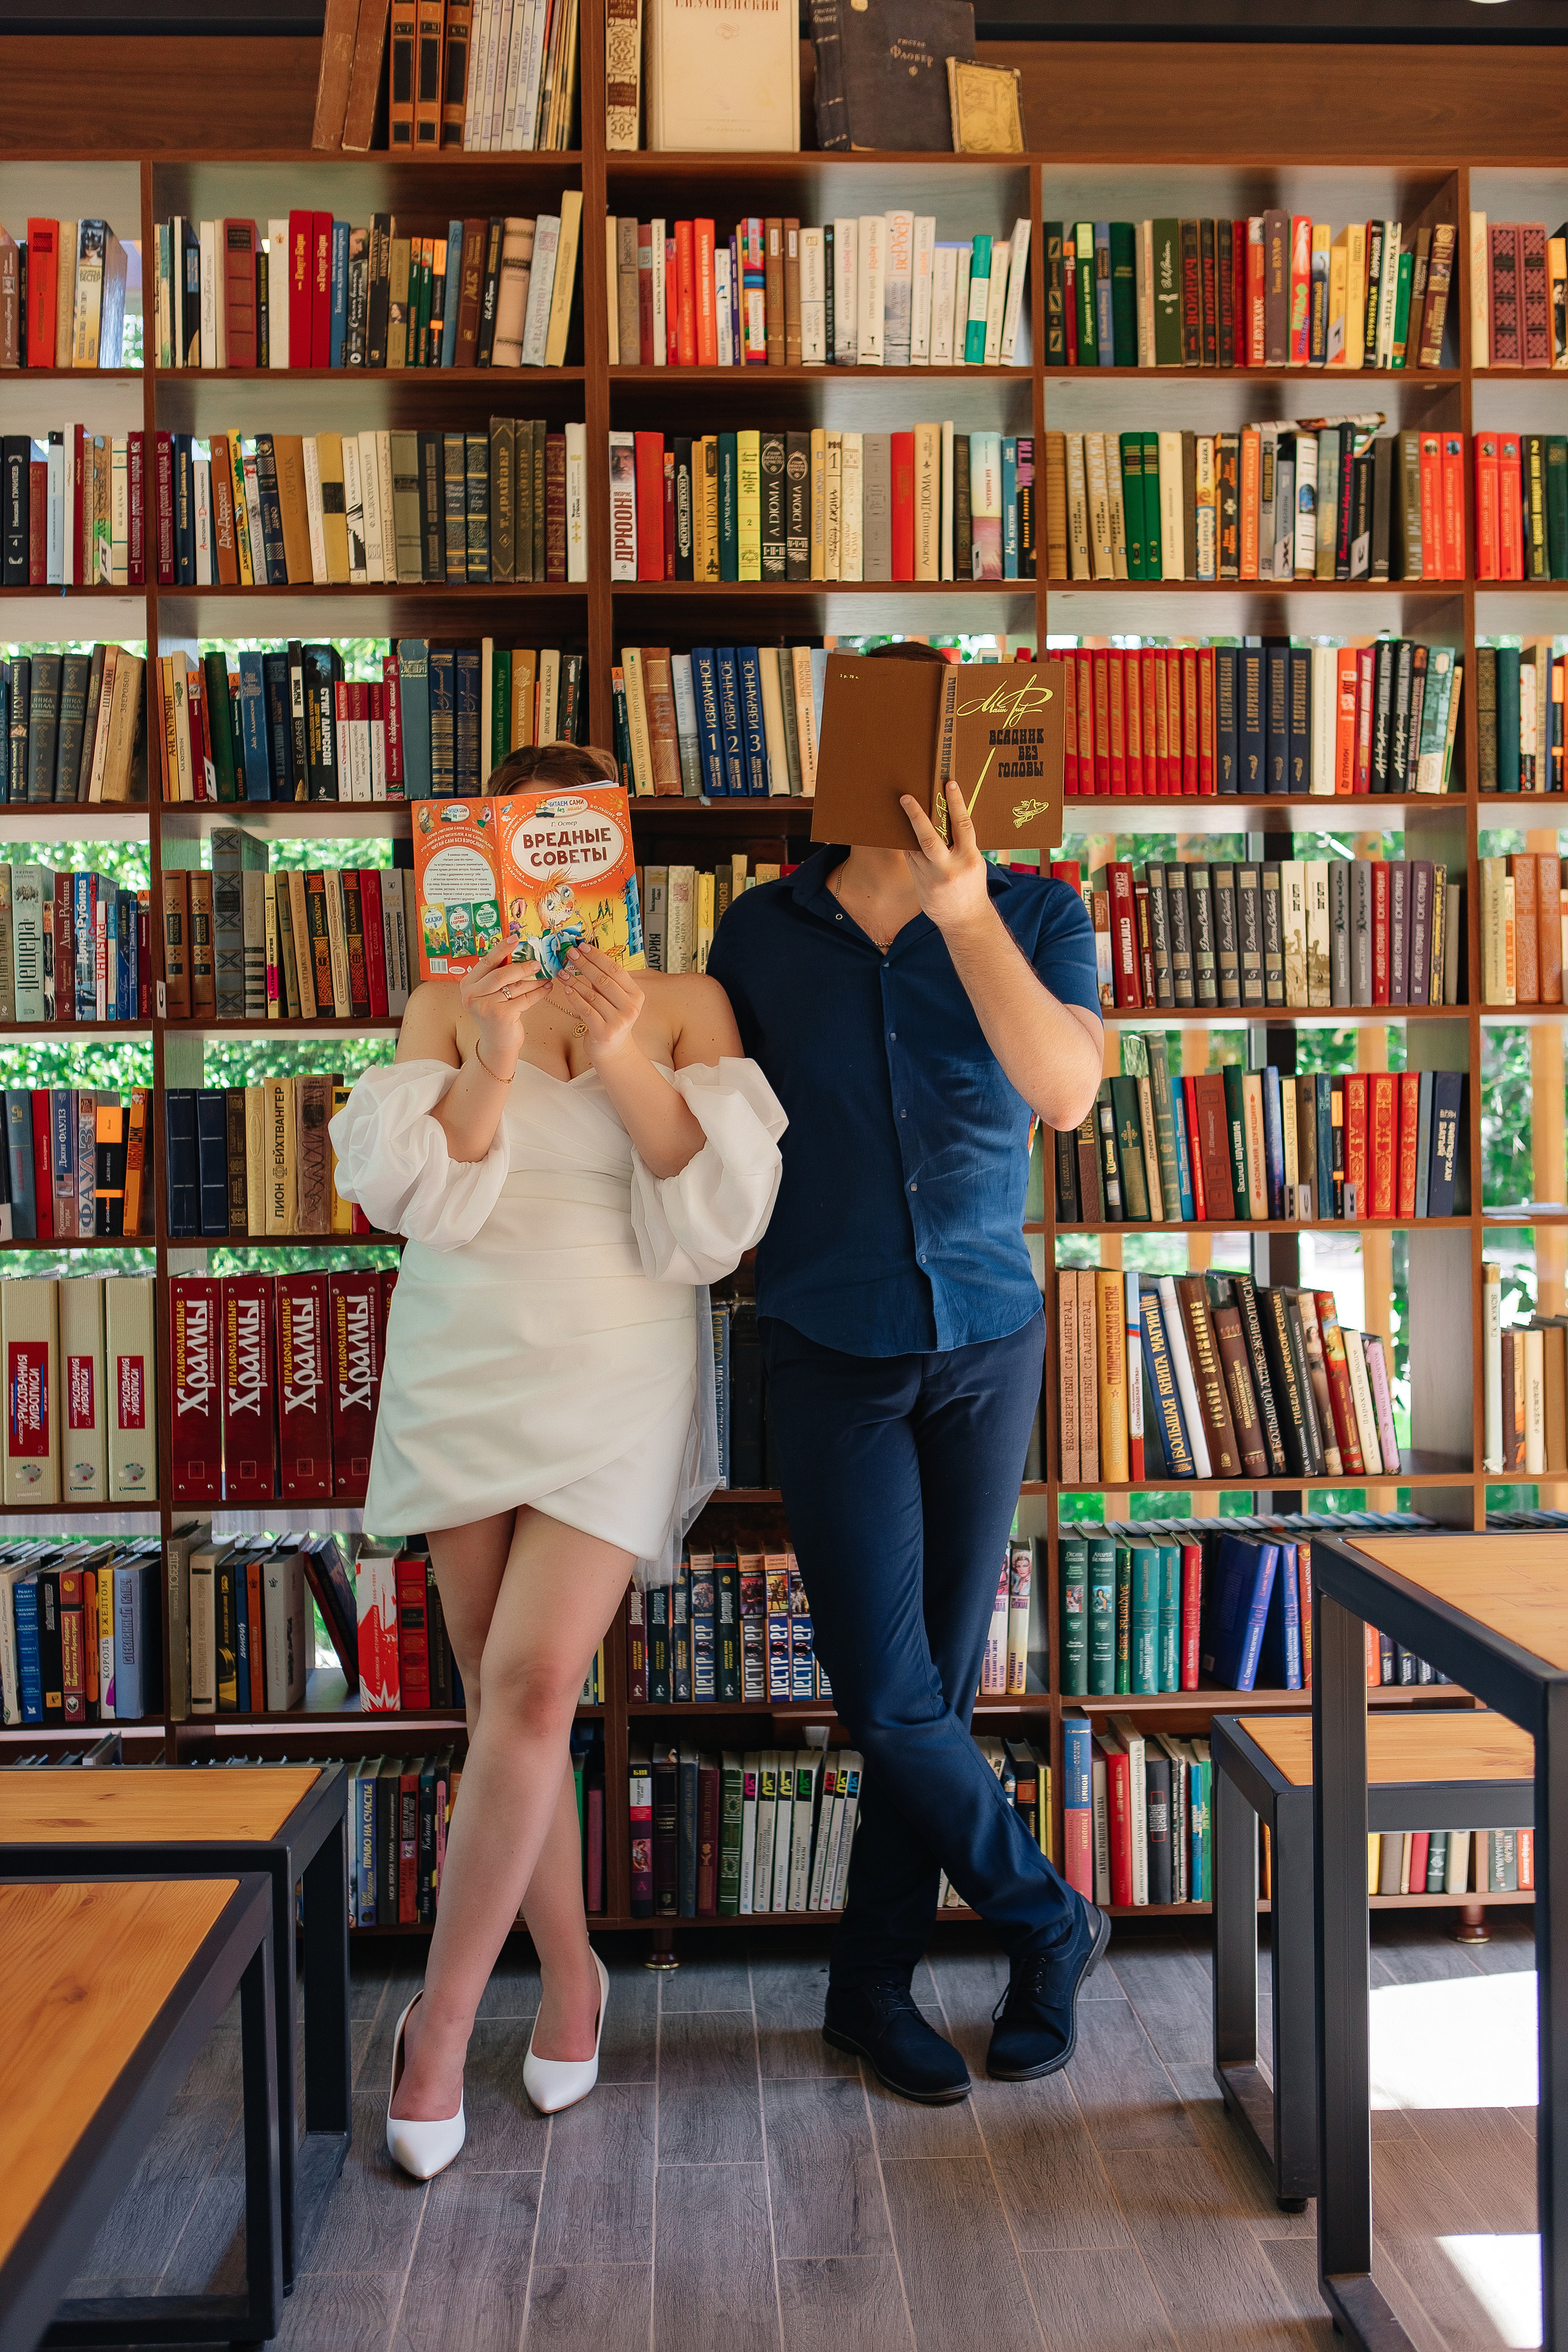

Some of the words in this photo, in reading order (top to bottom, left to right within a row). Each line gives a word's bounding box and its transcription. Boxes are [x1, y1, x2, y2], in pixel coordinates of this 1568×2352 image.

[614, 497, 634, 563] ДРЮОН
[102, 669, 114, 707] ШПИОН
[497, 669, 506, 690] Леру
[699, 660, 717, 728] ИЗБРАННОЕ
[721, 660, 736, 730] ИЗБРАННОЕ
[743, 660, 760, 729] ИЗБРАННОЕ
[945, 677, 957, 714] ГОЛОВЫ
[12, 696, 24, 719] КУН
[165, 695, 174, 736] КУПРИН
[322, 687, 330, 715] СТИГ
[323, 718, 331, 766] ЛАРССОН
[709, 733, 716, 750] 1
[728, 736, 739, 753] 2
[750, 735, 761, 752] 3
[944, 717, 954, 733] БЕЗ
[989, 728, 1044, 745] ВСАДНИК
[940, 736, 952, 780] ВСАДНИК
[998, 761, 1044, 777] ГОЛОВЫ
[1019, 745, 1038, 761] БЕЗ
[503, 813, 519, 838] ЛЮБИМЫЕ
[505, 829, 513, 851] ДЕТСКИЕ
[513, 810, 533, 829] ПИСАТЕЛИ
[522, 827, 612, 850] ВРЕДНЫЕ
[590, 804, 616, 818] БОЛЬШИЕ
[615, 817, 629, 834] БУКВЫ
[505, 863, 534, 889] УДАРЕНИЯМИ
[513, 865, 525, 878] СЛОВА
[530, 846, 608, 867] СОВЕТЫ
[598, 872, 612, 882] ВЗЯТЬ
[616, 853, 628, 869] СОБОЙ
[59, 881, 72, 918] Рубина
[77, 880, 88, 928] Рубина
[61, 920, 71, 949] Дина
[77, 929, 88, 964] Дина
[96, 924, 105, 980] РУБИНА
[17, 921, 40, 990] Пещера
[129, 1126, 143, 1144] ДНК
[272, 1087, 288, 1179] ФЕЙХТВАНГЕР
[58, 1144, 67, 1167] Джон
[79, 1129, 95, 1227] ФАУЛЗ
[274, 1183, 285, 1218] ЛИОН
[1104, 1285, 1120, 1311] БИТВА
[1242, 1280, 1264, 1350] ЖИВОПИСИ
[1273, 1294, 1286, 1330] СЕМЬИ
[176, 1300, 185, 1386] ПРАВОСЛАВНЫЕ
[228, 1300, 237, 1386] ПРАВОСЛАВНЫЕ
[282, 1298, 293, 1384] ПРАВОСЛАВНЫЕ
[337, 1295, 348, 1382] ПРАВОСЛАВНЫЕ
[1063, 1300, 1074, 1369] СТАЛИНГРАД
[1083, 1300, 1092, 1369] СТАЛИНГРАД
[1105, 1314, 1121, 1385] СТАЛИНГРАДСКАЯ
[1145, 1309, 1166, 1353] МАГИИ
[177, 1300, 216, 1417] Храмы
[228, 1300, 268, 1417] Храмы
[284, 1297, 324, 1414] Храмы
[339, 1295, 379, 1412] Храмы
[1279, 1332, 1295, 1382] ЦАРСКОЙ
[17, 1354, 28, 1420] РИСОВАНИЯ
[81, 1368, 89, 1416] ЖИВОПИСИ
[1153, 1354, 1174, 1395] КНИГА
[29, 1368, 40, 1430] ЖИВОПИСИ
[1063, 1376, 1074, 1451] БЕССМЕРТНЫЙ
[1082, 1376, 1093, 1451] БЕССМЕРТНЫЙ
[1261, 1388, 1281, 1449] БОЛЬШОЙ
[1287, 1384, 1303, 1425] ГИБЕЛЬ
[1110, 1401, 1123, 1465] ЭНЦИКЛОПЕДИЯ
[1162, 1398, 1186, 1459] БОЛЬШАЯ
[630, 1593, 644, 1625] Дестроер
[652, 1593, 666, 1624] Дестроер
[720, 1593, 733, 1623] Дестроер
[364, 1784, 372, 1823] СЧАСТЬЕ
[364, 1823, 371, 1838] НА
[363, 1839, 372, 1869] ПРАВО
